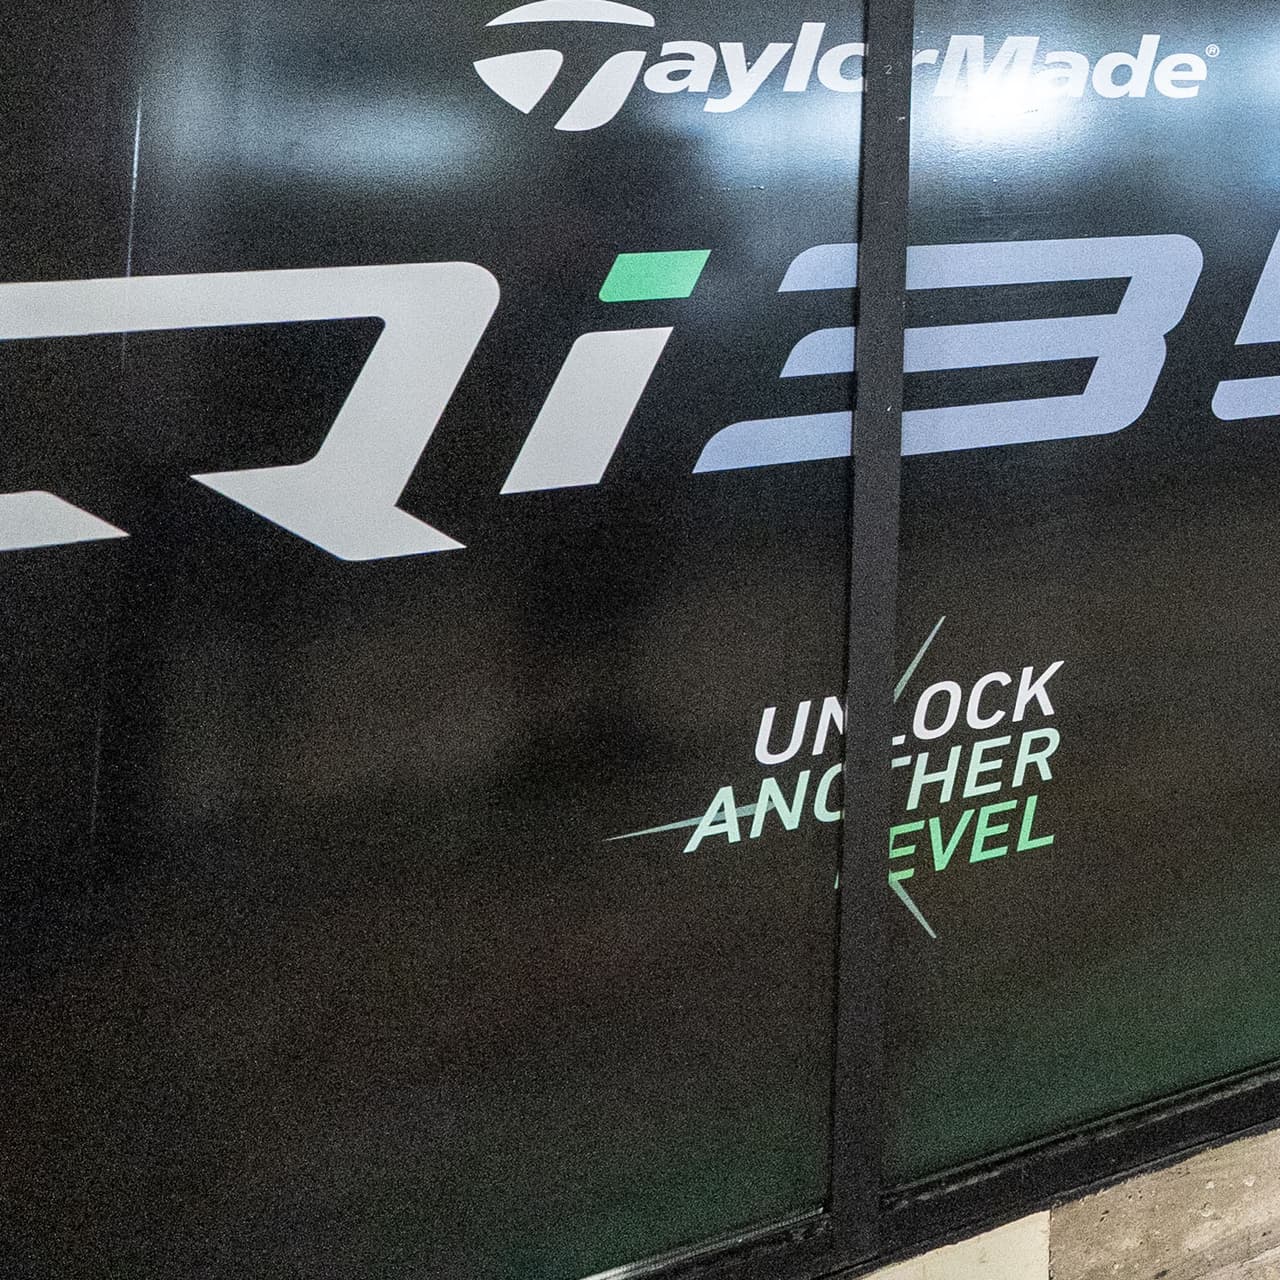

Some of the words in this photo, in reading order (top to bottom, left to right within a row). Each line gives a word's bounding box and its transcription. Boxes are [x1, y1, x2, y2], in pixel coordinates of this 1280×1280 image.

[754, 660, 1065, 766] UNOCK
[683, 727, 1061, 854] ANOHER
[834, 795, 1055, 889] EVEL
